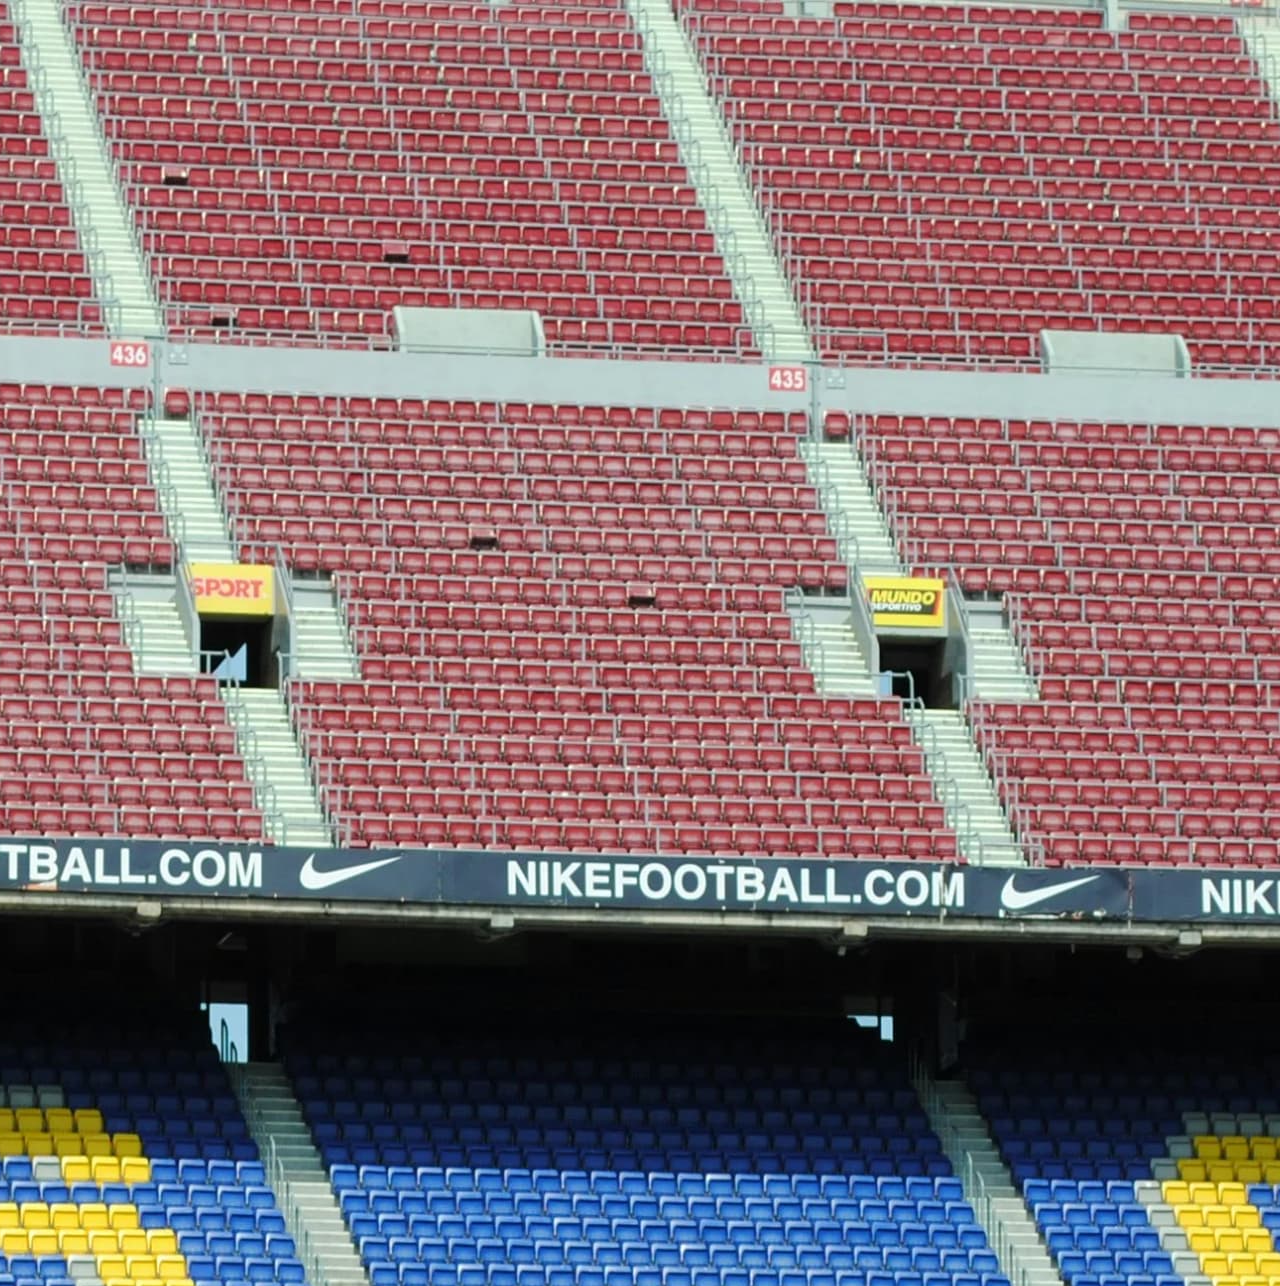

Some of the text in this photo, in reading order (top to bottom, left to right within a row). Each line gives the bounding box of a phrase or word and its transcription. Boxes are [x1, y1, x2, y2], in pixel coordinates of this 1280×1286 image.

[111, 345, 147, 365] 436
[770, 370, 804, 389] 435
[191, 577, 263, 599] SPORT
[871, 590, 936, 606] MUNDO
[507, 861, 965, 906] NIKEFOOTBALL.COM
